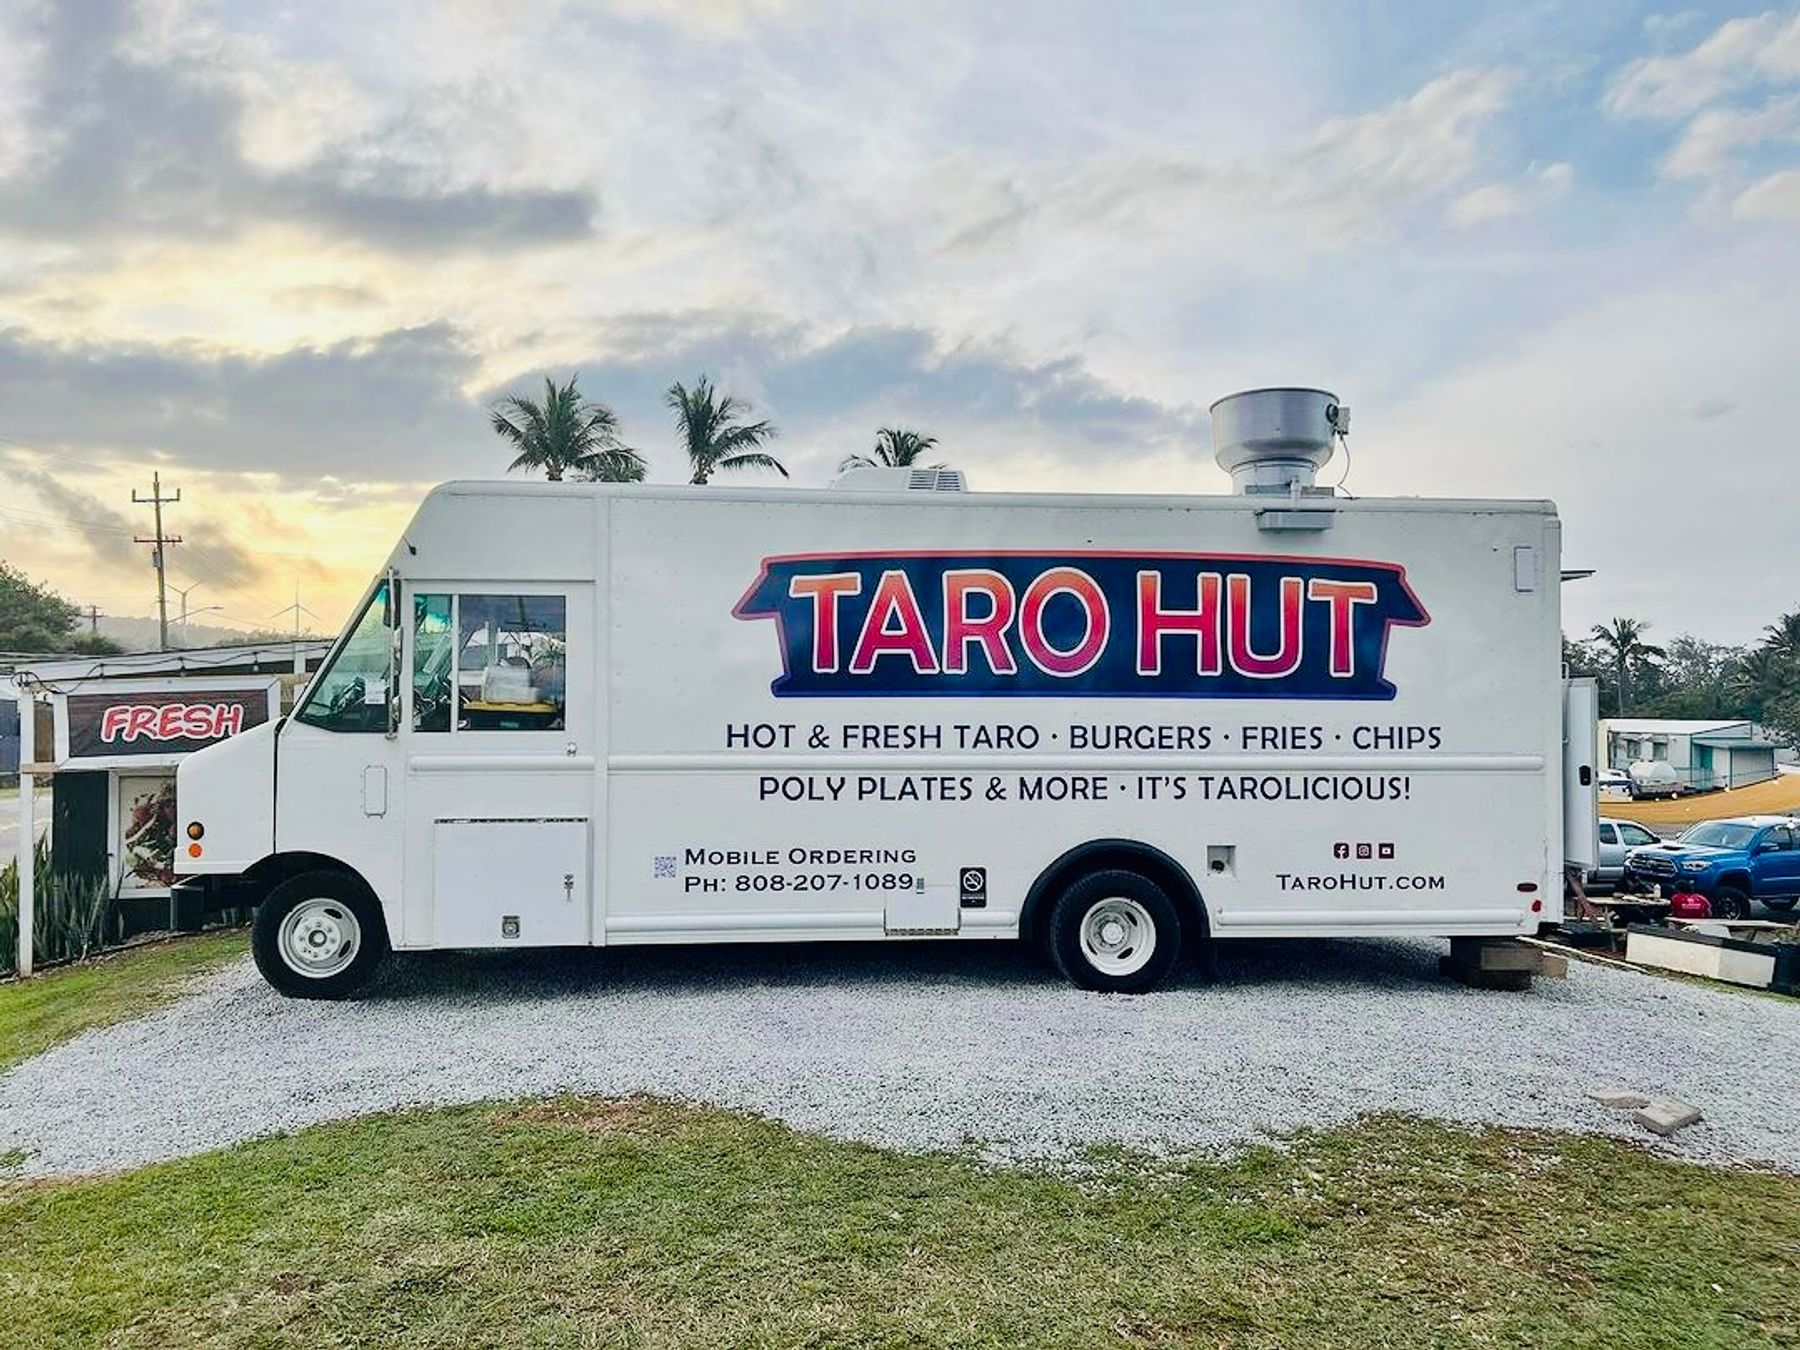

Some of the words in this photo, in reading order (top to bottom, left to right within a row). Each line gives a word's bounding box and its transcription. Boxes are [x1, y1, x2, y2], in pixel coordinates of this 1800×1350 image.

[788, 566, 1111, 678] TARO
[1136, 569, 1378, 678] HUT
[101, 704, 243, 742] FRESH
[726, 723, 797, 749] HOT
[807, 724, 830, 750] &
[842, 724, 942, 750] FRESH
[953, 724, 1040, 750] TARO
[1069, 724, 1212, 750] BURGERS
[1241, 726, 1323, 750] FRIES
[1352, 726, 1442, 750] CHIPS
[759, 776, 846, 801] POLY
[858, 776, 973, 801] PLATES
[984, 776, 1007, 802] &
[1019, 776, 1108, 801] MORE
[1137, 776, 1187, 800] IT'S
[1197, 776, 1411, 801] TAROLICIOUS!
[734, 874, 914, 892] 808-207-1089
